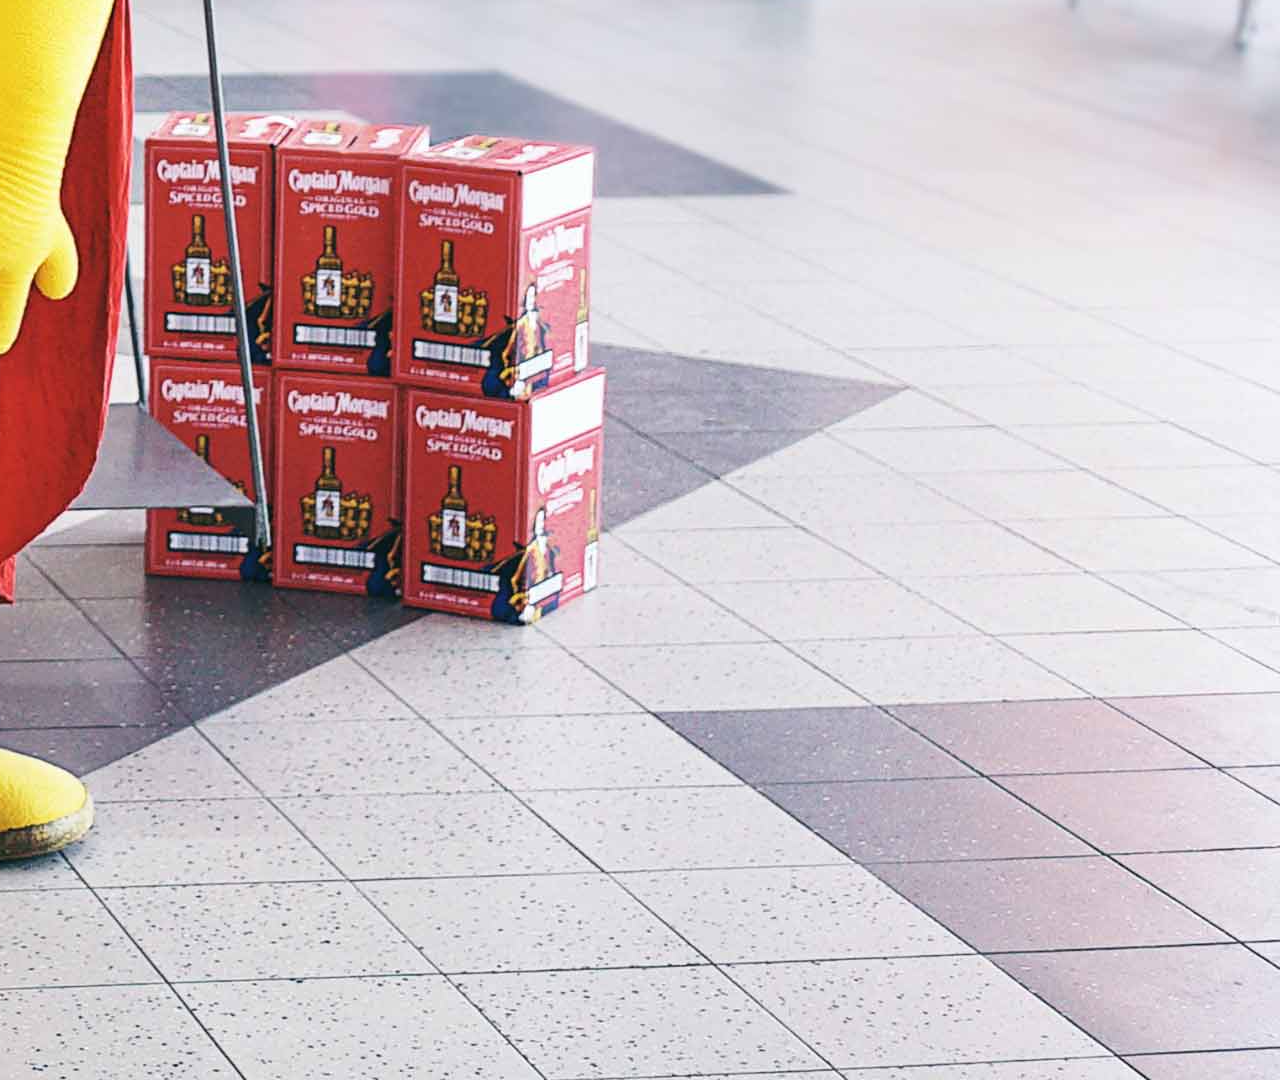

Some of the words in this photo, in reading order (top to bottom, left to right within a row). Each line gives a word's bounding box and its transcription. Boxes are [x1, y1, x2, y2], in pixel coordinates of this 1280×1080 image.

[157, 160, 205, 183] Captain
[202, 160, 258, 185] Mrgan
[288, 169, 338, 193] Captain
[335, 170, 392, 195] Morgan
[212, 192, 247, 207] GD
[409, 180, 455, 204] Captain
[452, 184, 507, 213] Morgan
[342, 204, 379, 217] GOLD
[460, 219, 494, 234] GOLD
[161, 379, 210, 402] Captain
[287, 390, 336, 414] Captain
[334, 392, 390, 419] Morgan
[214, 413, 248, 426] GOL
[416, 405, 462, 429] Captain
[460, 409, 514, 439] Morgan
[342, 426, 378, 440] GOLD
[469, 446, 503, 460] GOLD
